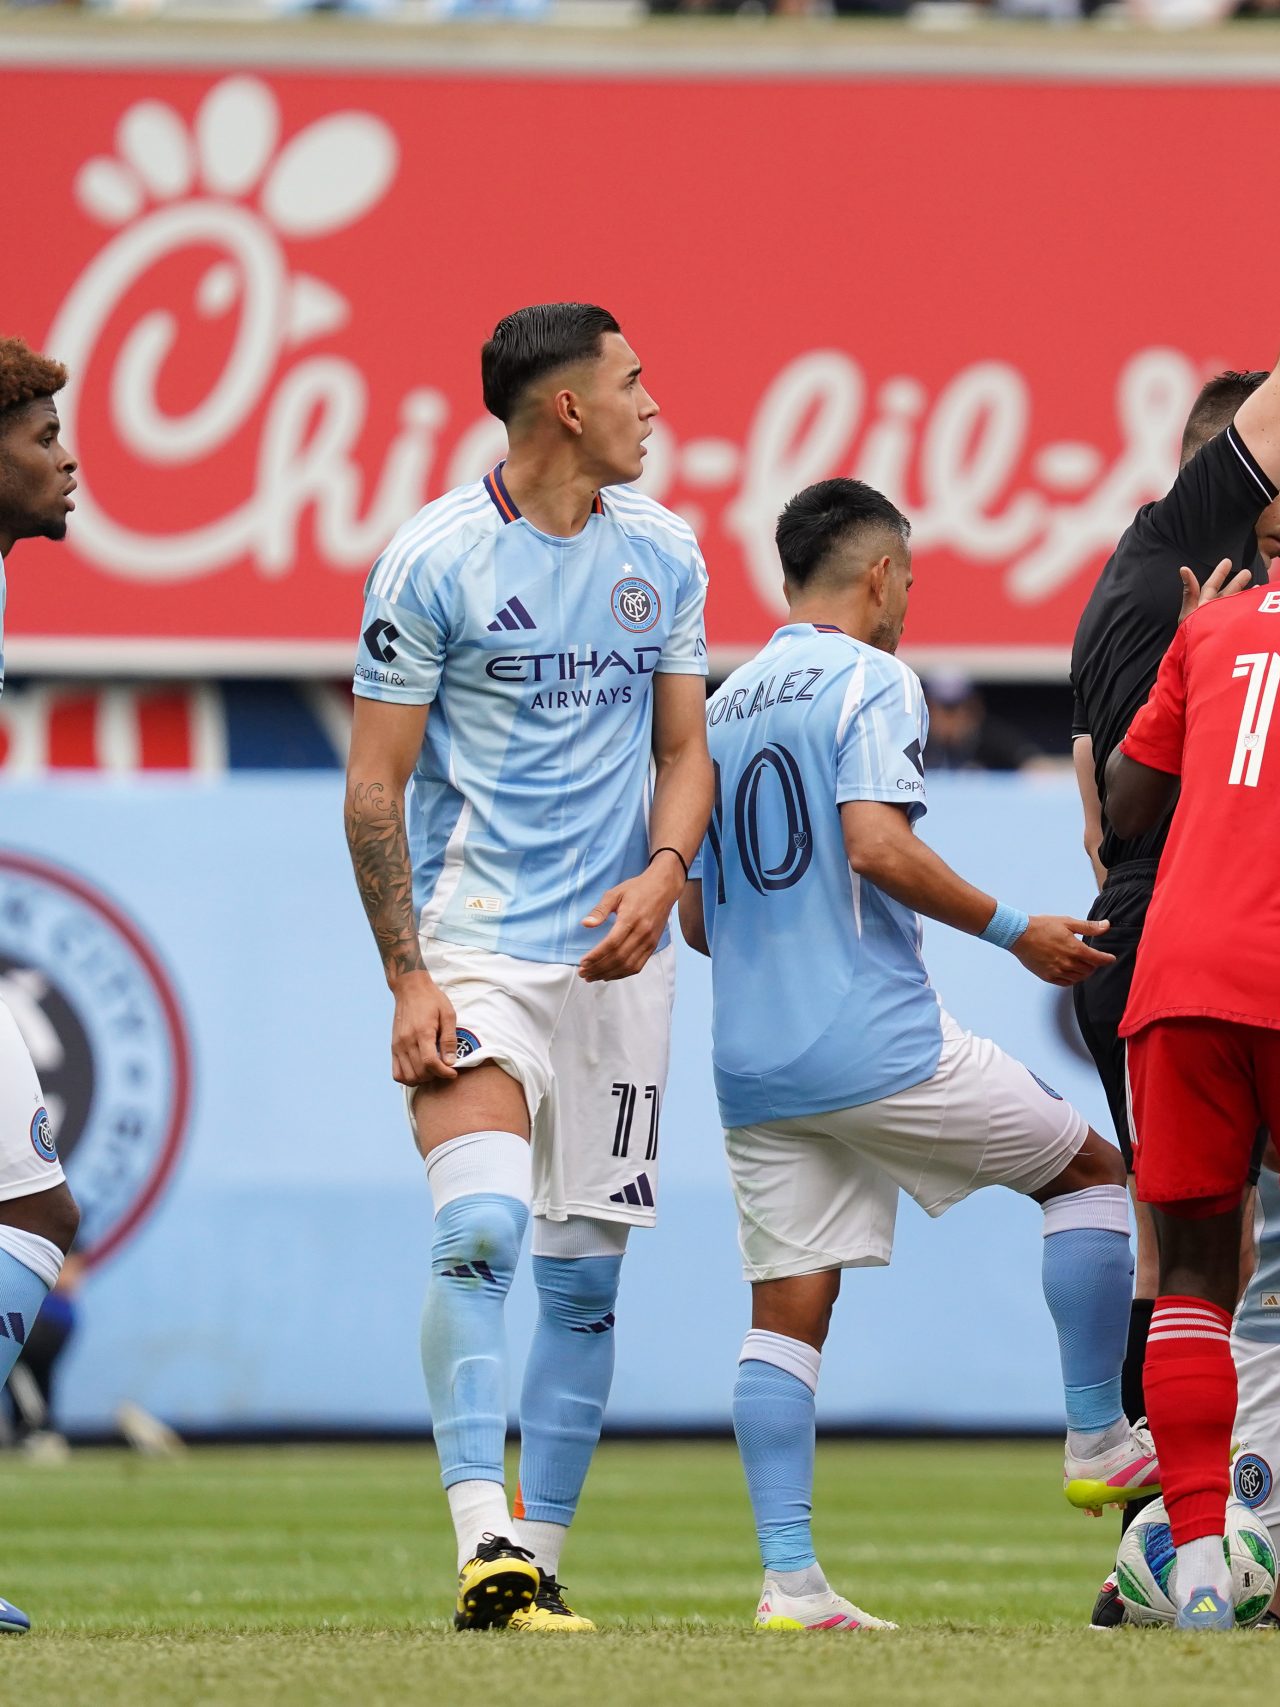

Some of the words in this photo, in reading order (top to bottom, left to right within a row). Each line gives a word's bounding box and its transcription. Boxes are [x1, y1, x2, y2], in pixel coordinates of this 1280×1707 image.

[355, 663, 389, 684] Capital
[390, 672, 406, 687] Rx
[485, 645, 662, 682] ETIHAD
[531, 686, 632, 710] AIRWAYS
[611, 1082, 660, 1161] 11
